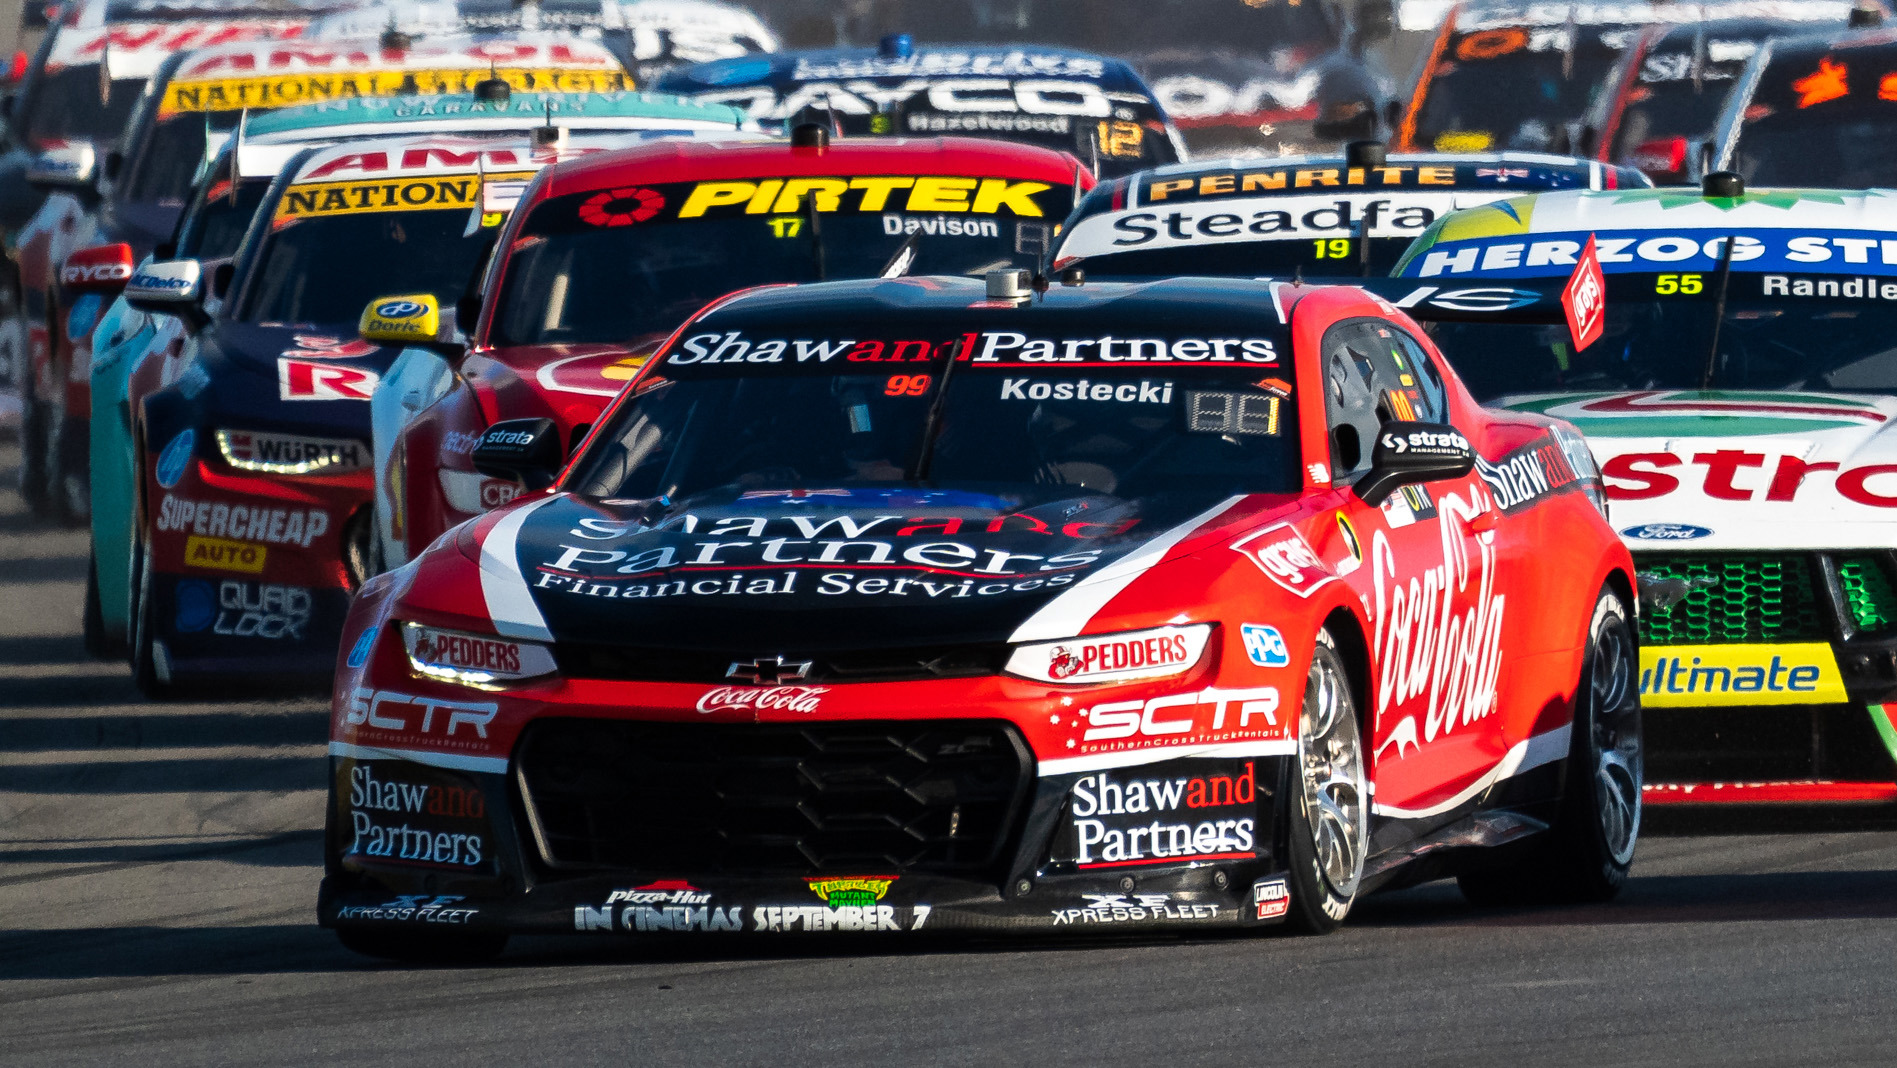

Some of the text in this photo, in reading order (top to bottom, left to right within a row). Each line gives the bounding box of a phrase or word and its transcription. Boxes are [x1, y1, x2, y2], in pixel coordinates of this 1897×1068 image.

[907, 112, 1069, 133] Hazelwood
[1149, 166, 1457, 201] PENRITE
[678, 177, 1053, 218] PIRTEK
[767, 217, 805, 239] 17
[882, 214, 999, 238] Davison
[1112, 199, 1436, 246] Steadfa
[1313, 238, 1351, 260] 19
[1419, 236, 1766, 278] HERZOG
[62, 264, 131, 282] RYCO
[1655, 274, 1703, 295] 55
[1763, 275, 1897, 300] Randle
[884, 374, 932, 396] 99
[1000, 378, 1174, 404] Kostecki
[486, 429, 534, 445] strata
[1408, 431, 1470, 450] strata
[1410, 447, 1460, 455] MANAGEMENT
[156, 493, 329, 548] SUPERCHEAP
[1638, 525, 1696, 540] Ford
[192, 543, 258, 565] AUTO
[543, 537, 1103, 574] Partners
[533, 571, 1076, 598] Financial Services
[220, 581, 312, 616] QUAD
[435, 634, 521, 673] PEDDERS
[1082, 633, 1188, 672] PEDDERS
[1244, 628, 1285, 661] PPG
[346, 687, 499, 739] SCTR
[1083, 686, 1280, 742] SCTR
[350, 810, 482, 866] Partners
[1074, 817, 1255, 865] Partners
[1256, 884, 1284, 902] LINCOLN
[337, 905, 480, 924] XPRESS FLEET
[574, 905, 932, 932] IN CINEMAS SEPTEMBER 7
[1051, 903, 1220, 926] XPRESS FLEET
[1260, 901, 1286, 916] ELECTRIC
